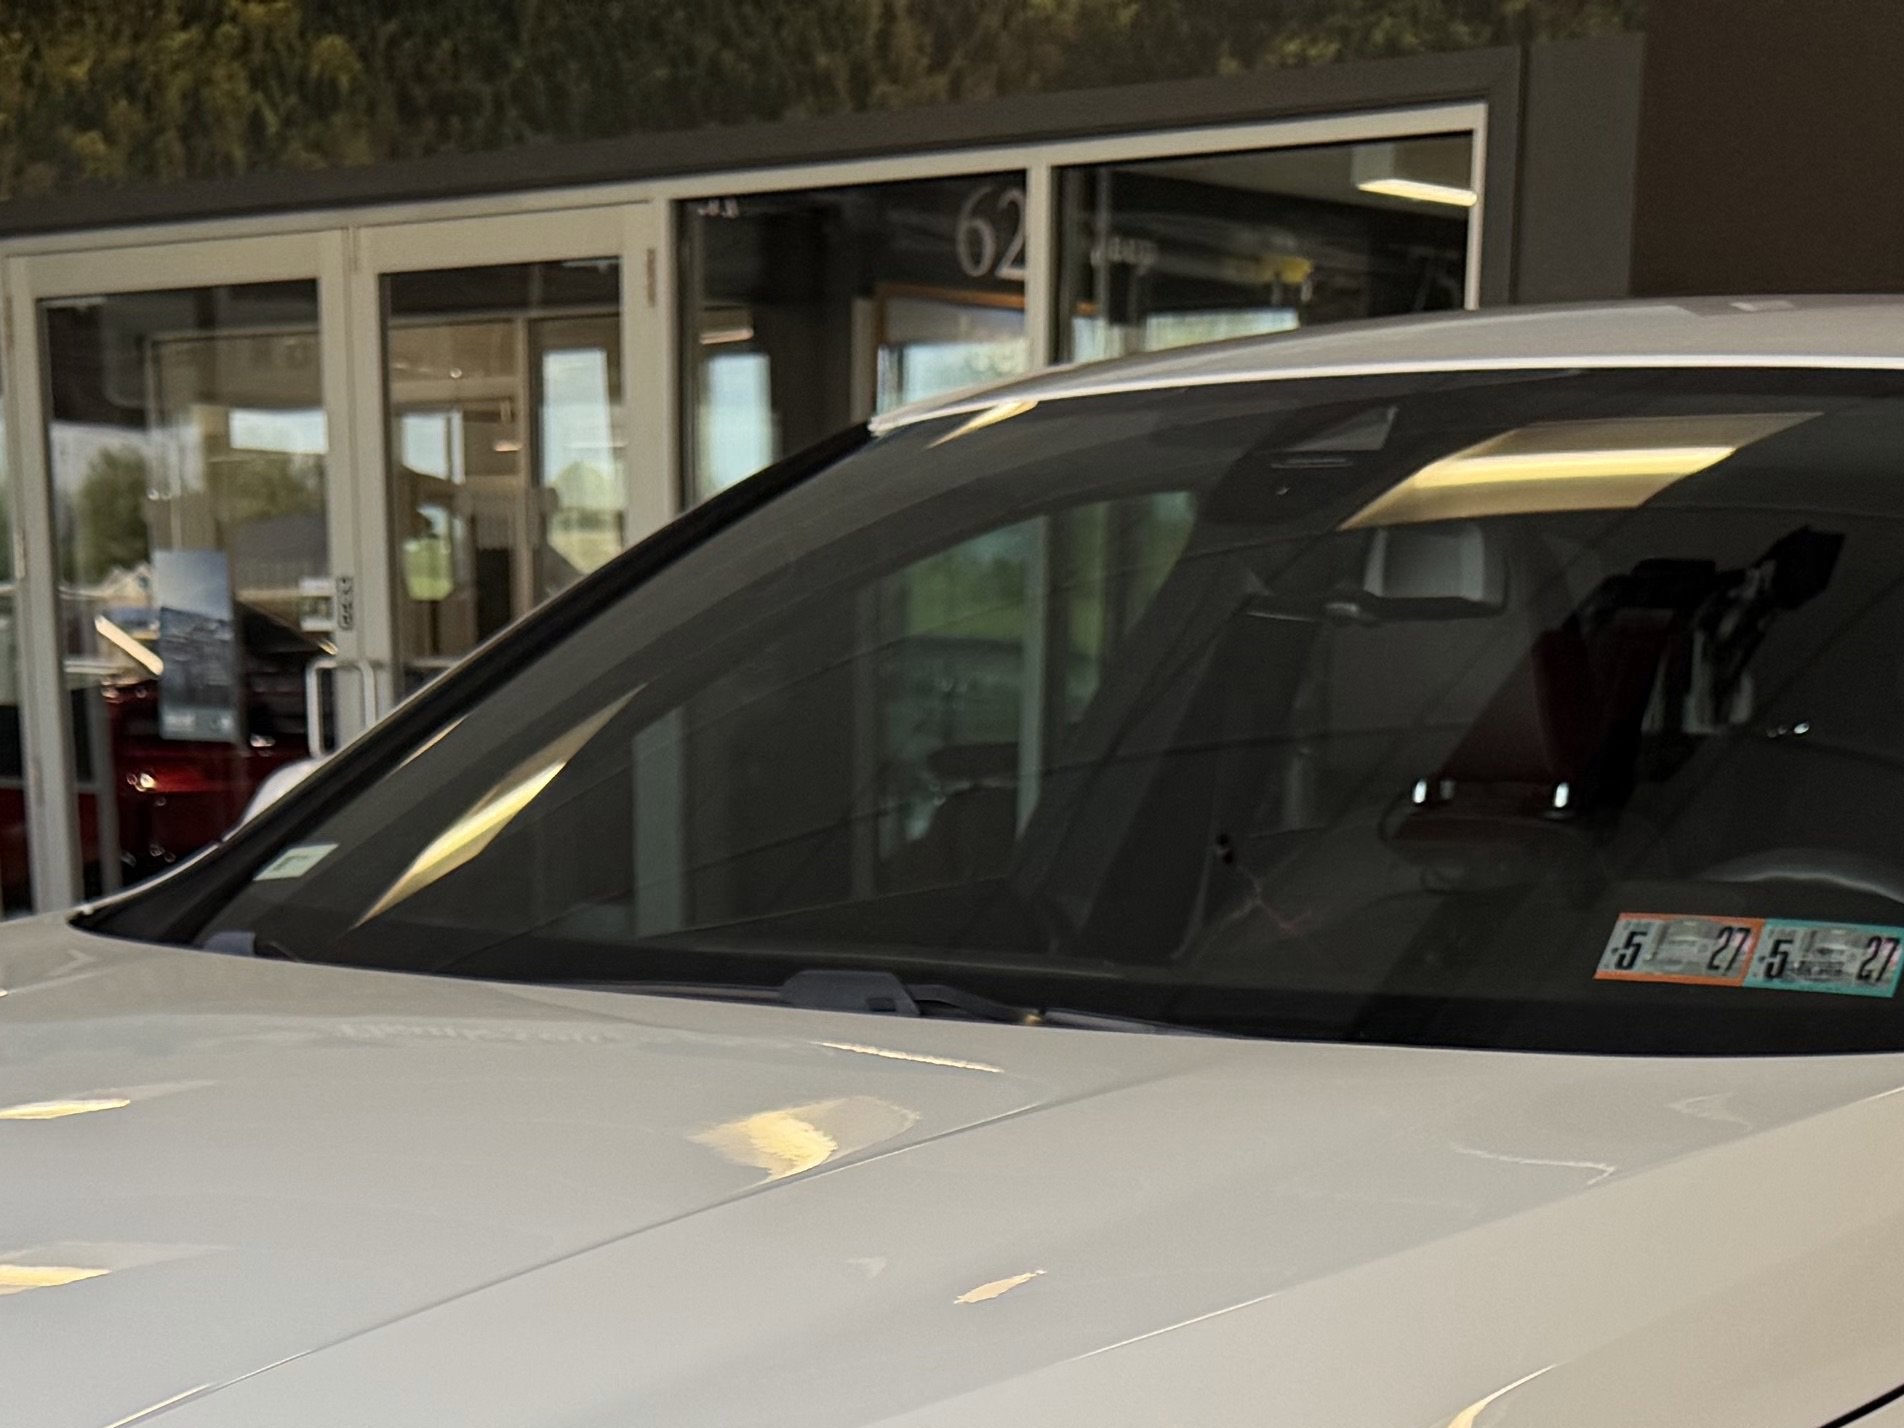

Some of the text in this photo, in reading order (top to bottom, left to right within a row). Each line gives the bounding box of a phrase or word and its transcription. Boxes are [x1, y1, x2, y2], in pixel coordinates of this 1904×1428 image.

[1614, 930, 1648, 971] 5
[1706, 925, 1752, 973] 27
[1763, 938, 1794, 979] 5
[1856, 935, 1901, 983] 27
